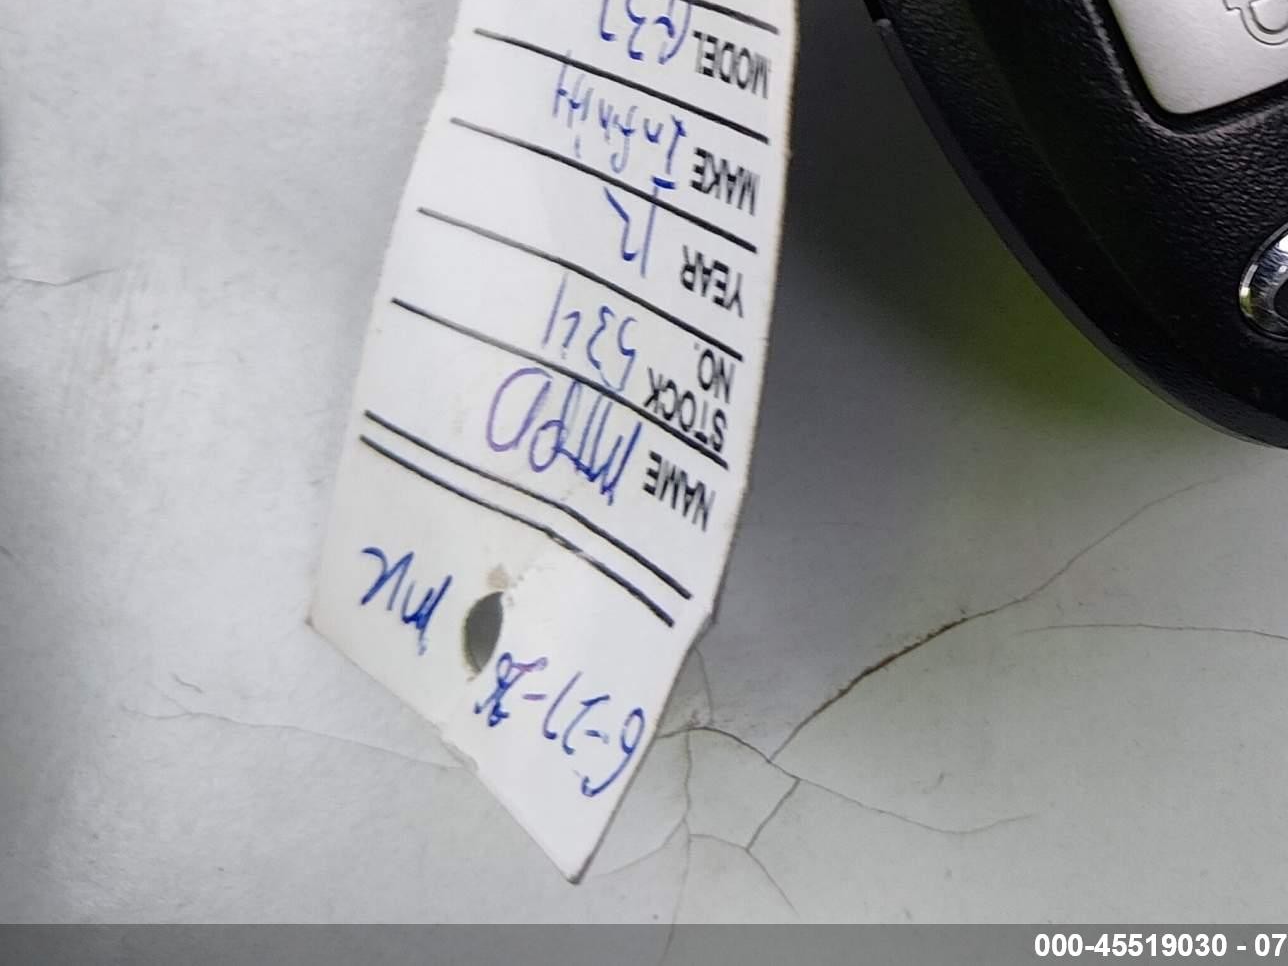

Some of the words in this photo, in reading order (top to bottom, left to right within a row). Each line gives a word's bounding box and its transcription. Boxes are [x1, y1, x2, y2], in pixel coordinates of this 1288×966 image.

[693, 30, 772, 99] MODEL
[691, 147, 760, 216] MAKE
[680, 245, 743, 318] YEAR
[693, 342, 735, 404] NO.
[644, 366, 728, 454] STOCK
[643, 450, 715, 532] NAME
